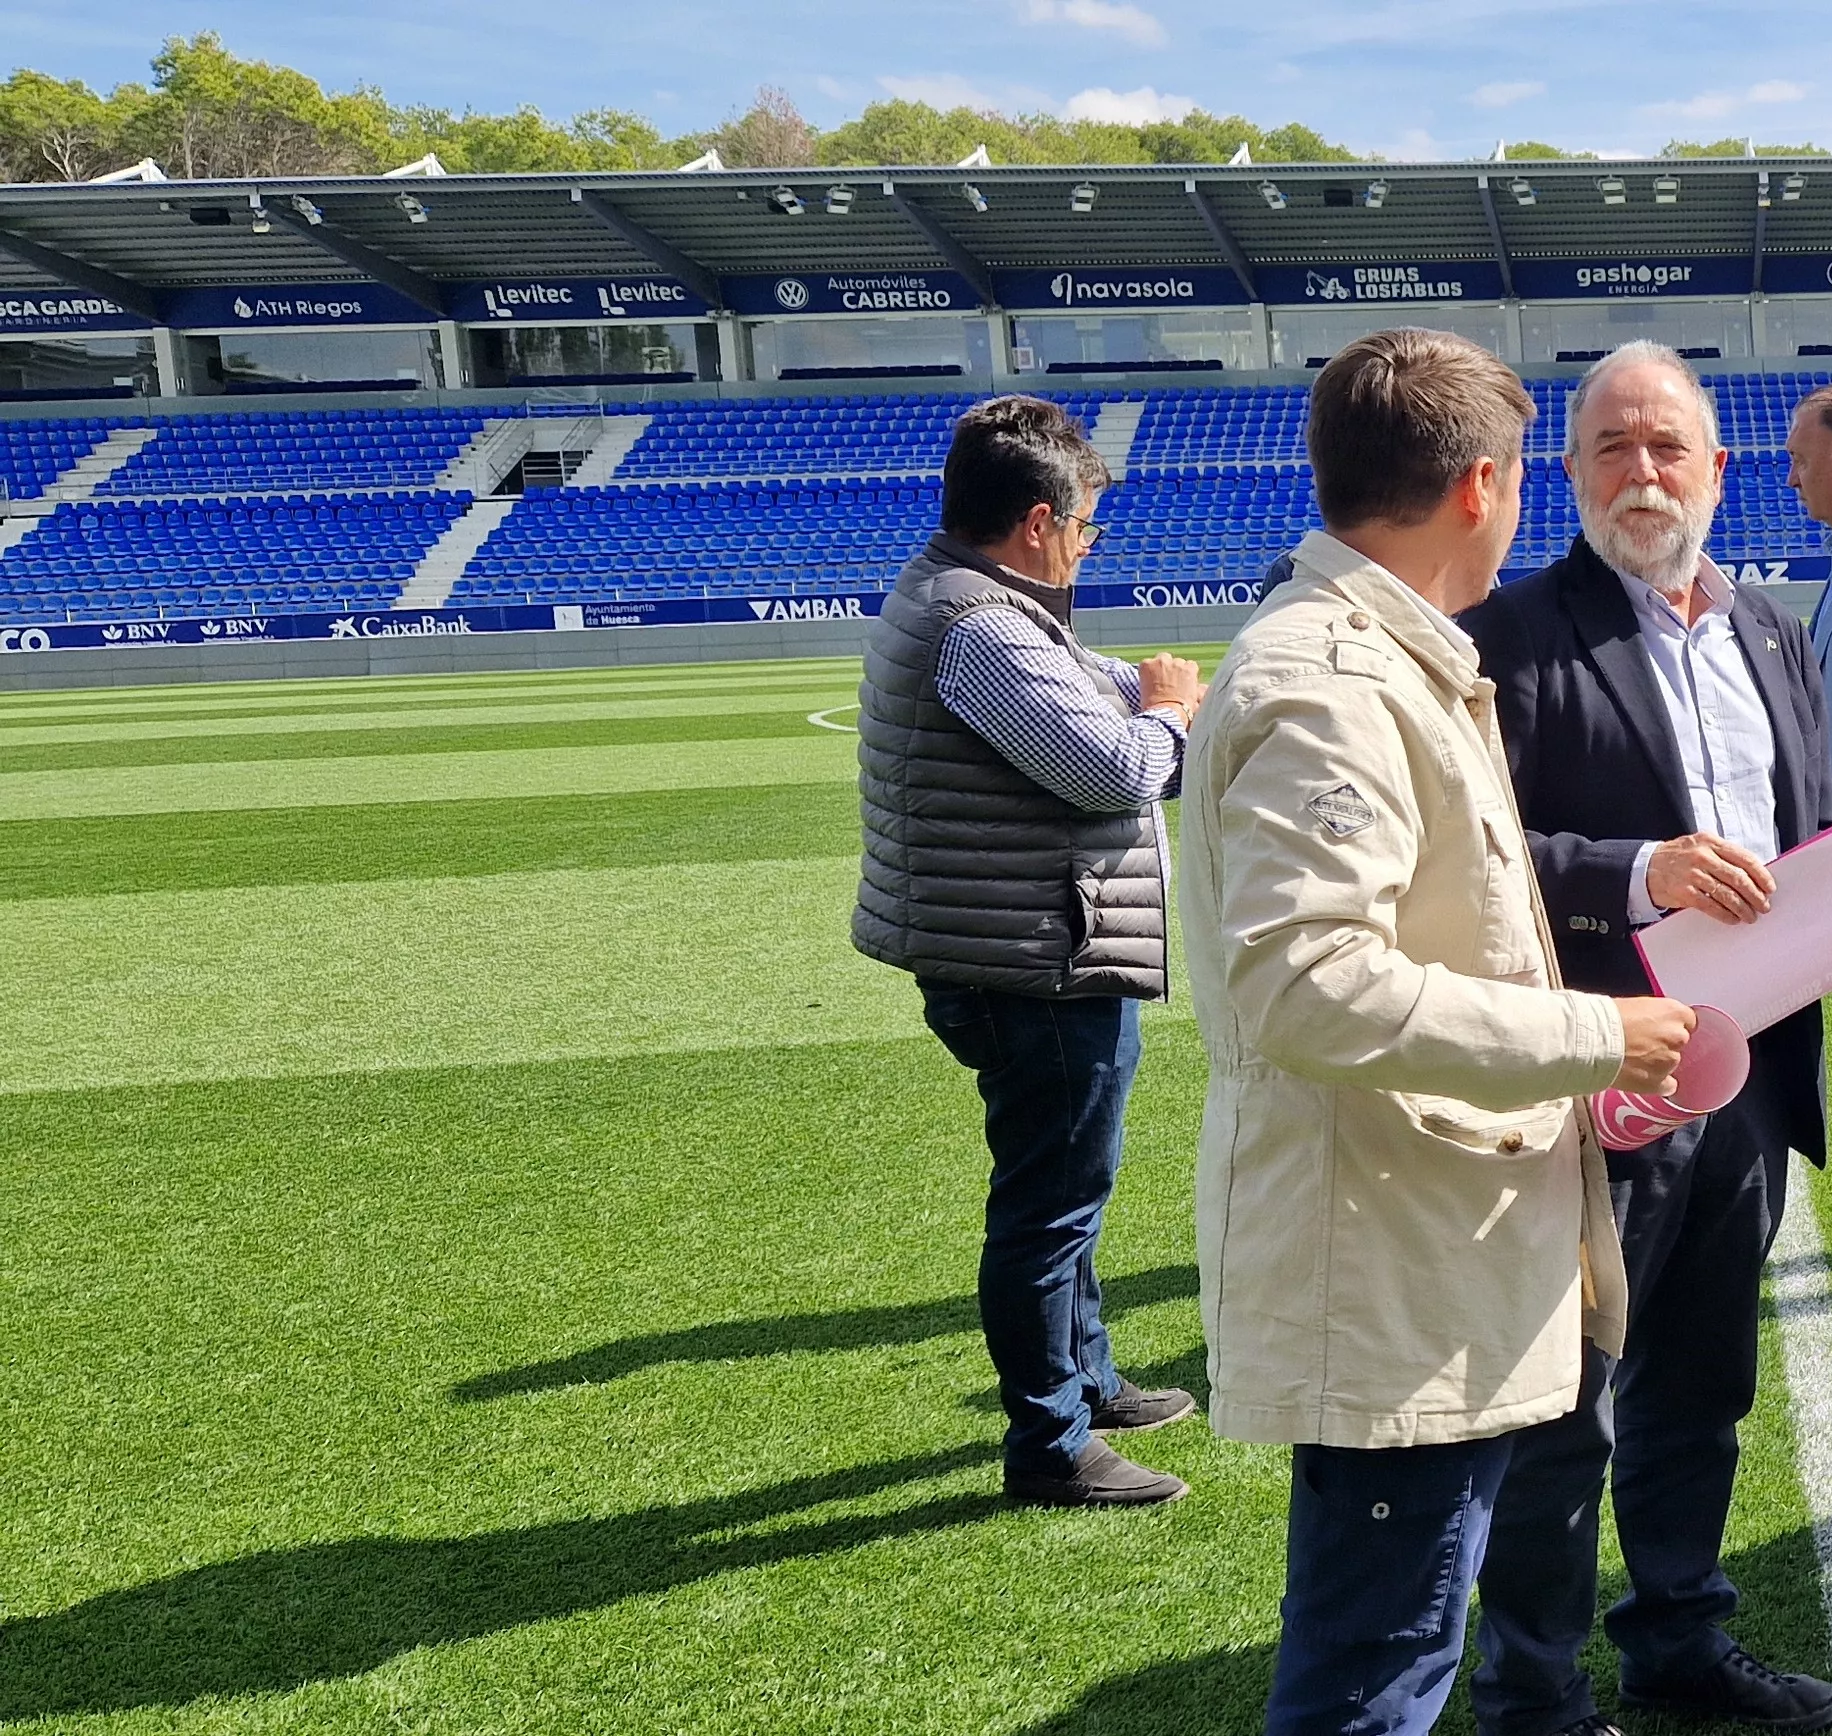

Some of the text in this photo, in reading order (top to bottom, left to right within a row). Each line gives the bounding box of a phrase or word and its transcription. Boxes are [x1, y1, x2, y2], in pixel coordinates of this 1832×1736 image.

[827, 275, 927, 290] Automóviles
[1353, 267, 1420, 283] GRUAS
[1576, 263, 1693, 287] gashogar
[1076, 278, 1194, 298] navasola
[1355, 282, 1463, 299] LOSFABLOS
[255, 299, 292, 317] ATH
[842, 290, 951, 310] CABRERO
[585, 603, 657, 616] Ayuntamiento
[771, 597, 865, 620] AMBAR
[225, 619, 270, 636] BNV
[361, 614, 473, 637] CaixaBank
[585, 614, 641, 626] de Huesca
[128, 623, 172, 640] BNV
